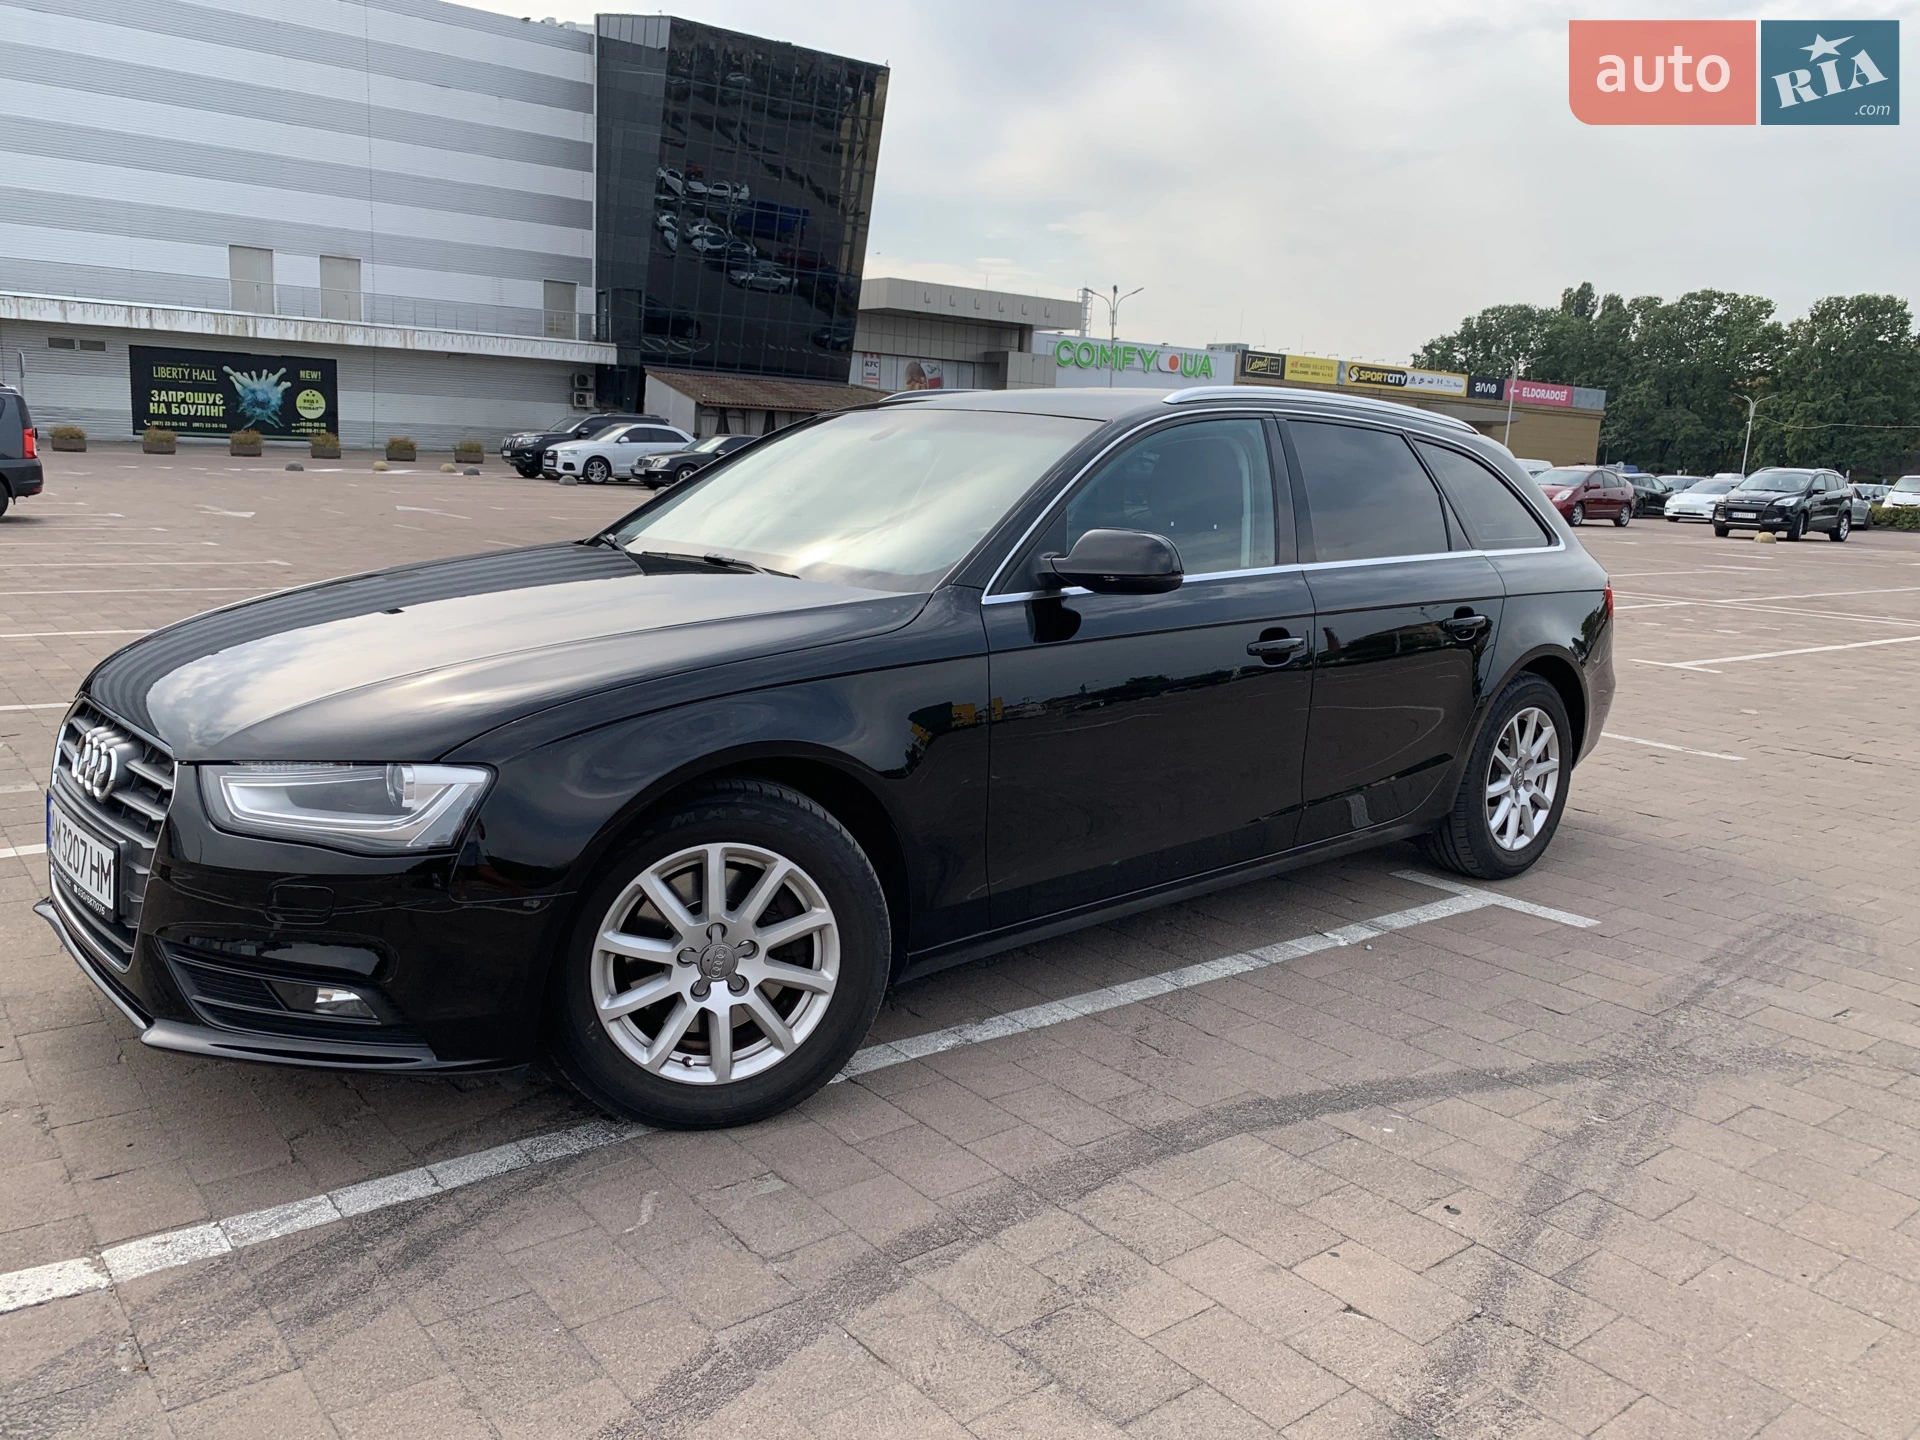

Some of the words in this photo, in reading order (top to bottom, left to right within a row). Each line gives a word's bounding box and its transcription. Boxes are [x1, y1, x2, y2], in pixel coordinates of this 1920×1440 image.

[864, 360, 879, 368] KFC
[1055, 339, 1159, 374] COMFY
[1181, 352, 1213, 378] UA
[152, 366, 190, 380] LIBERTY
[192, 368, 217, 382] HALL
[299, 370, 321, 379] NEW!
[1359, 370, 1407, 385] SPORTCITY
[150, 389, 224, 405] ЗАПРОШУЄ
[1522, 386, 1561, 400] ELDORADO
[149, 402, 168, 414] НА
[171, 403, 226, 417] БОУЛІНГ
[62, 821, 87, 879] 3207
[90, 845, 113, 901] HM
